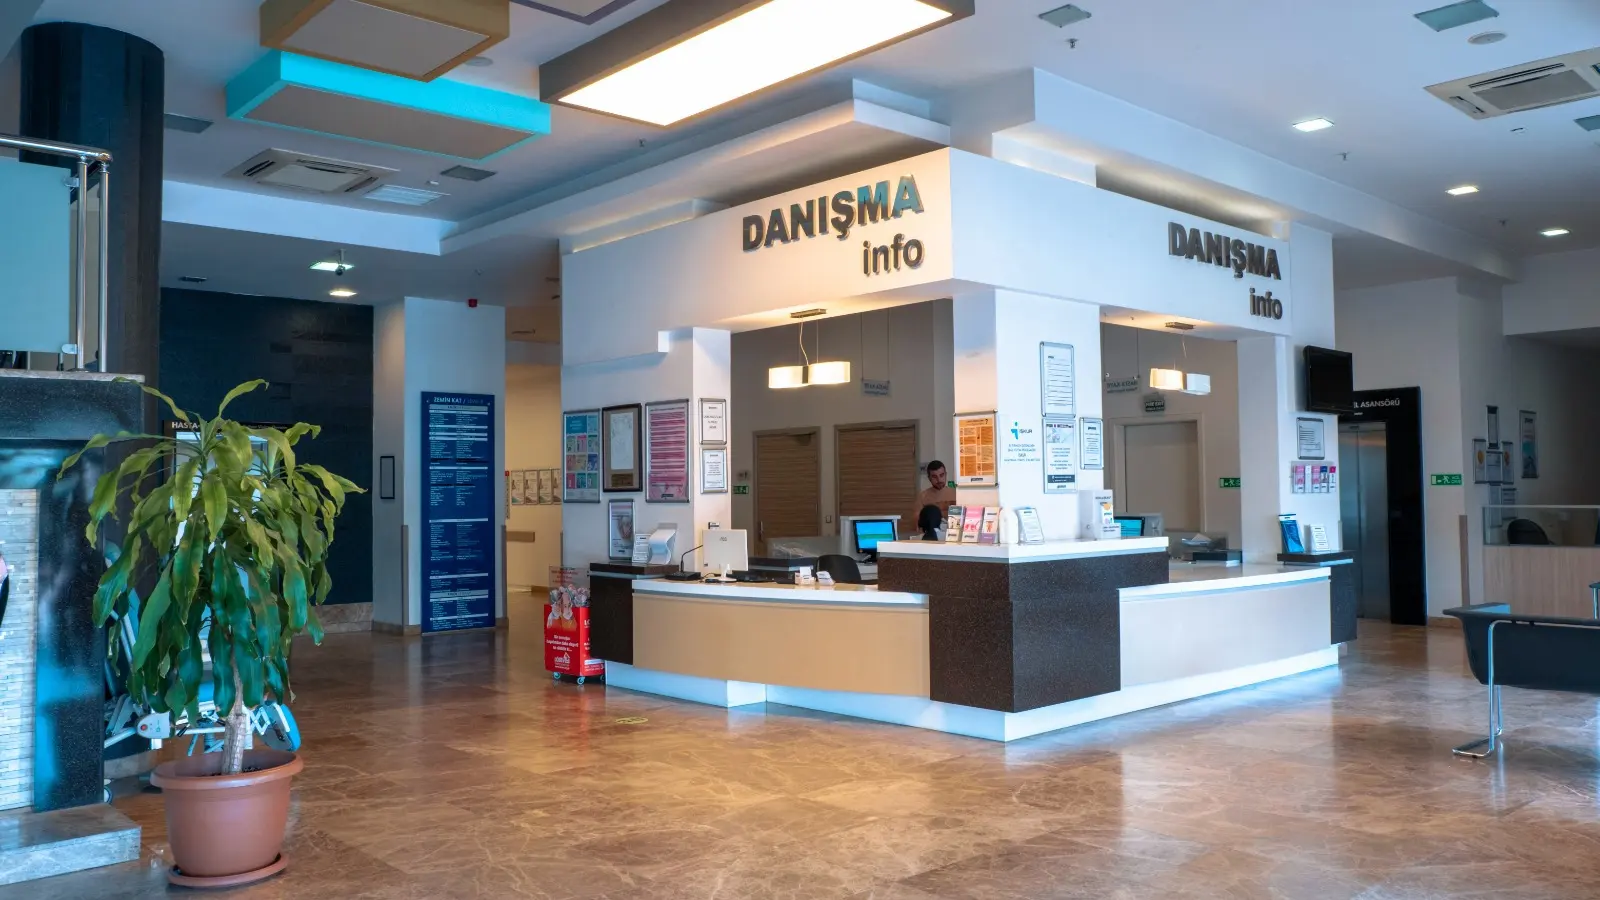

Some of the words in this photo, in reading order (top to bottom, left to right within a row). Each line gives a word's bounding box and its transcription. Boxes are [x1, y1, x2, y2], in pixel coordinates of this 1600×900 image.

[743, 174, 925, 252] DANIŞMA
[863, 233, 925, 277] info
[1168, 222, 1281, 280] DANIŞMA
[1249, 287, 1283, 320] info
[1360, 397, 1400, 408] ASANSÖRÜ
